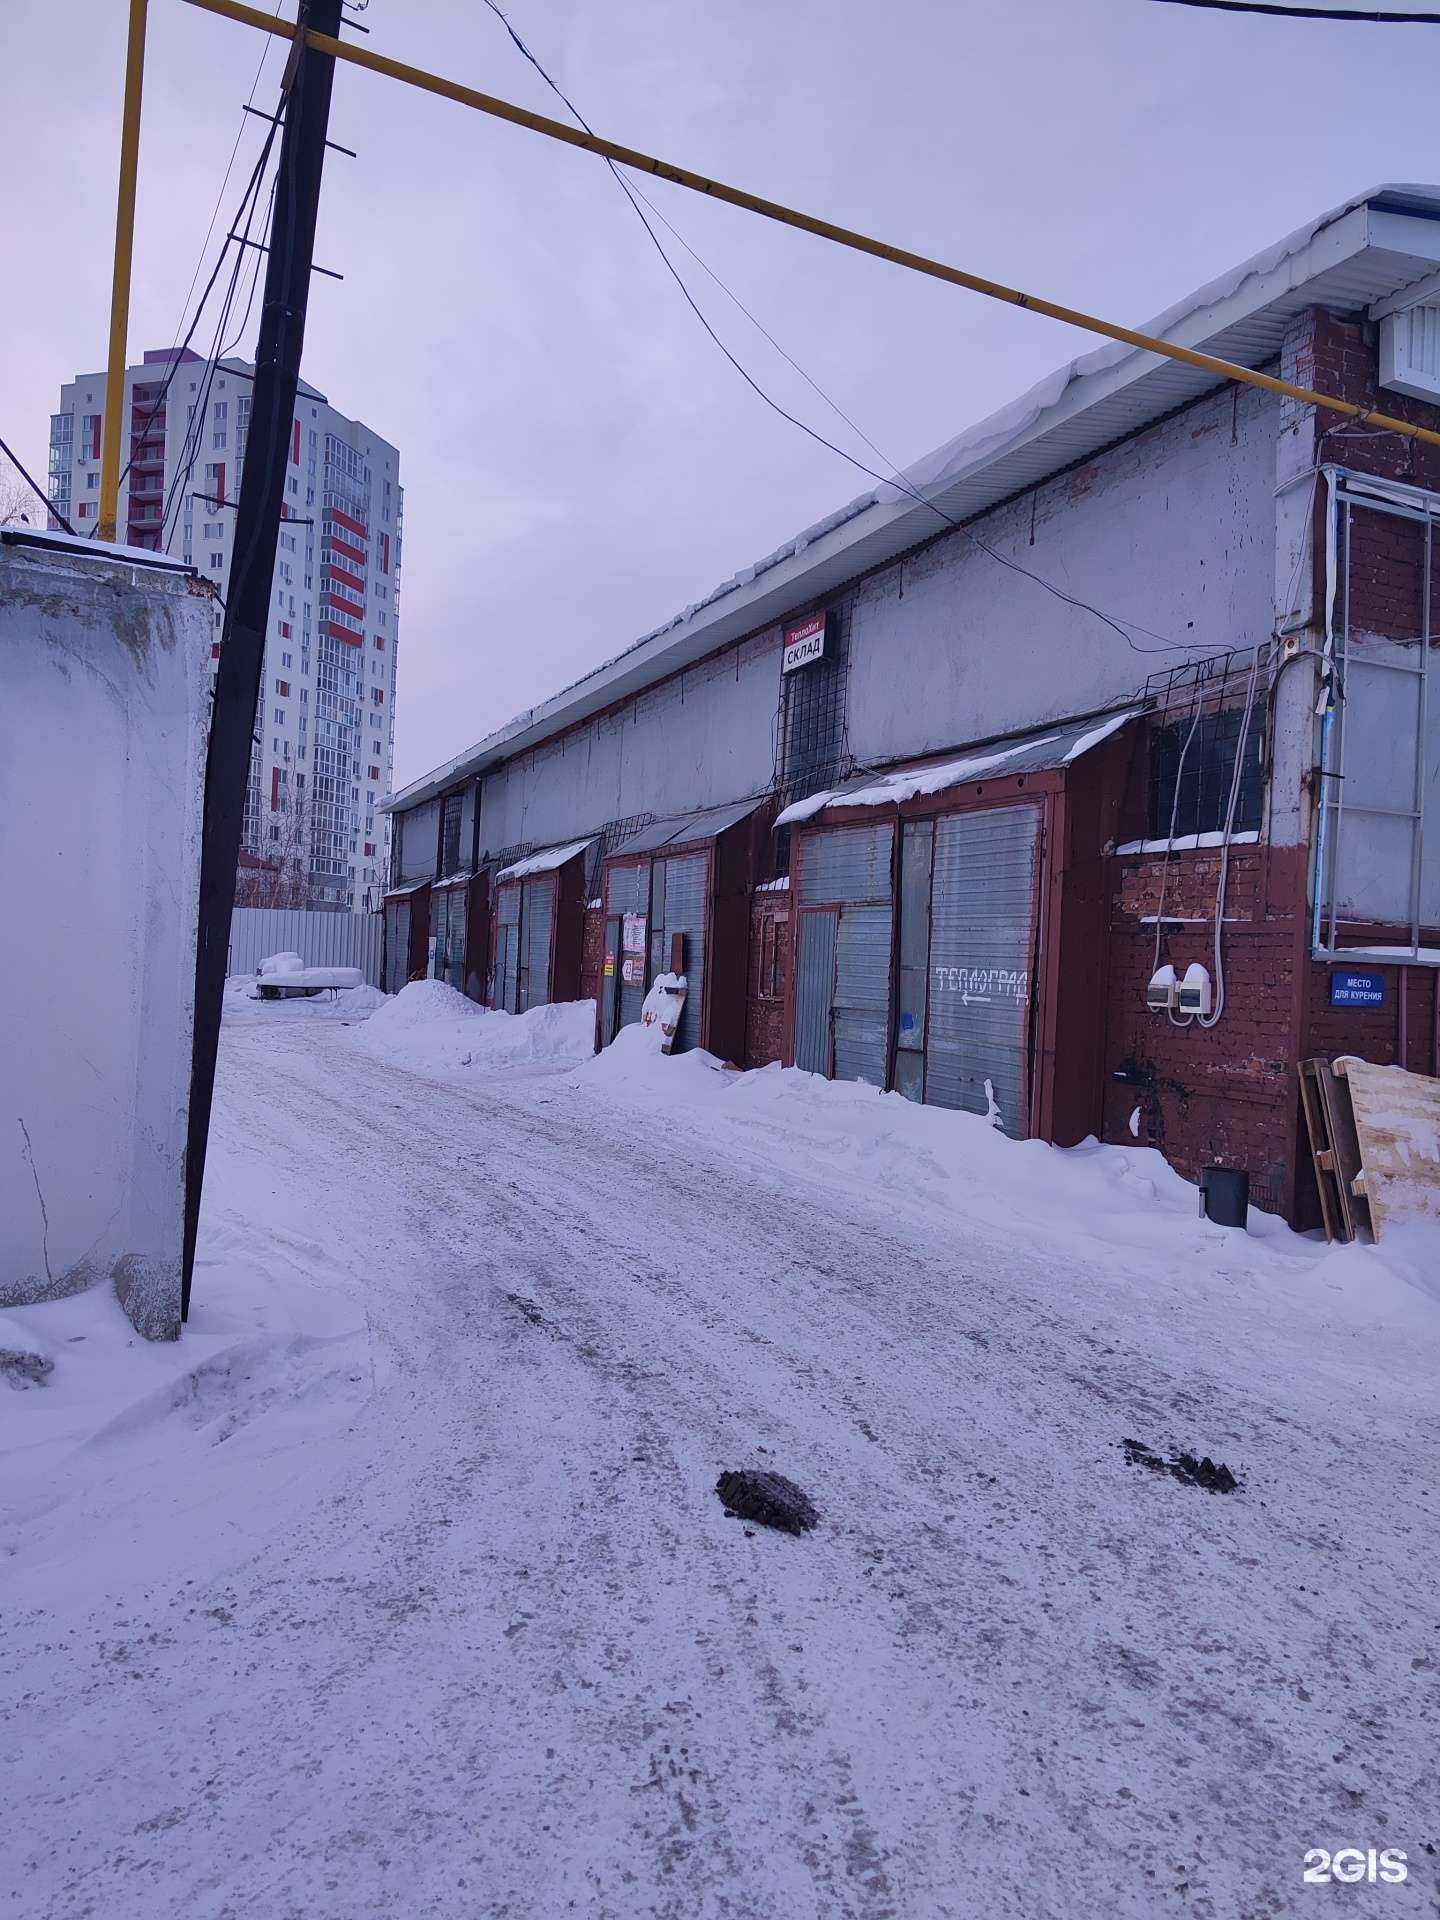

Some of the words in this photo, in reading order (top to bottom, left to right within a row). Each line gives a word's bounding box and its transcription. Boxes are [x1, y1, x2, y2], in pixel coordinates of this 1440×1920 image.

[787, 637, 821, 665] СКЛАД
[1347, 978, 1372, 989] МЕСТО
[1334, 989, 1349, 1000] ДЛЯ
[1350, 990, 1383, 1001] КУРЕНИЯ
